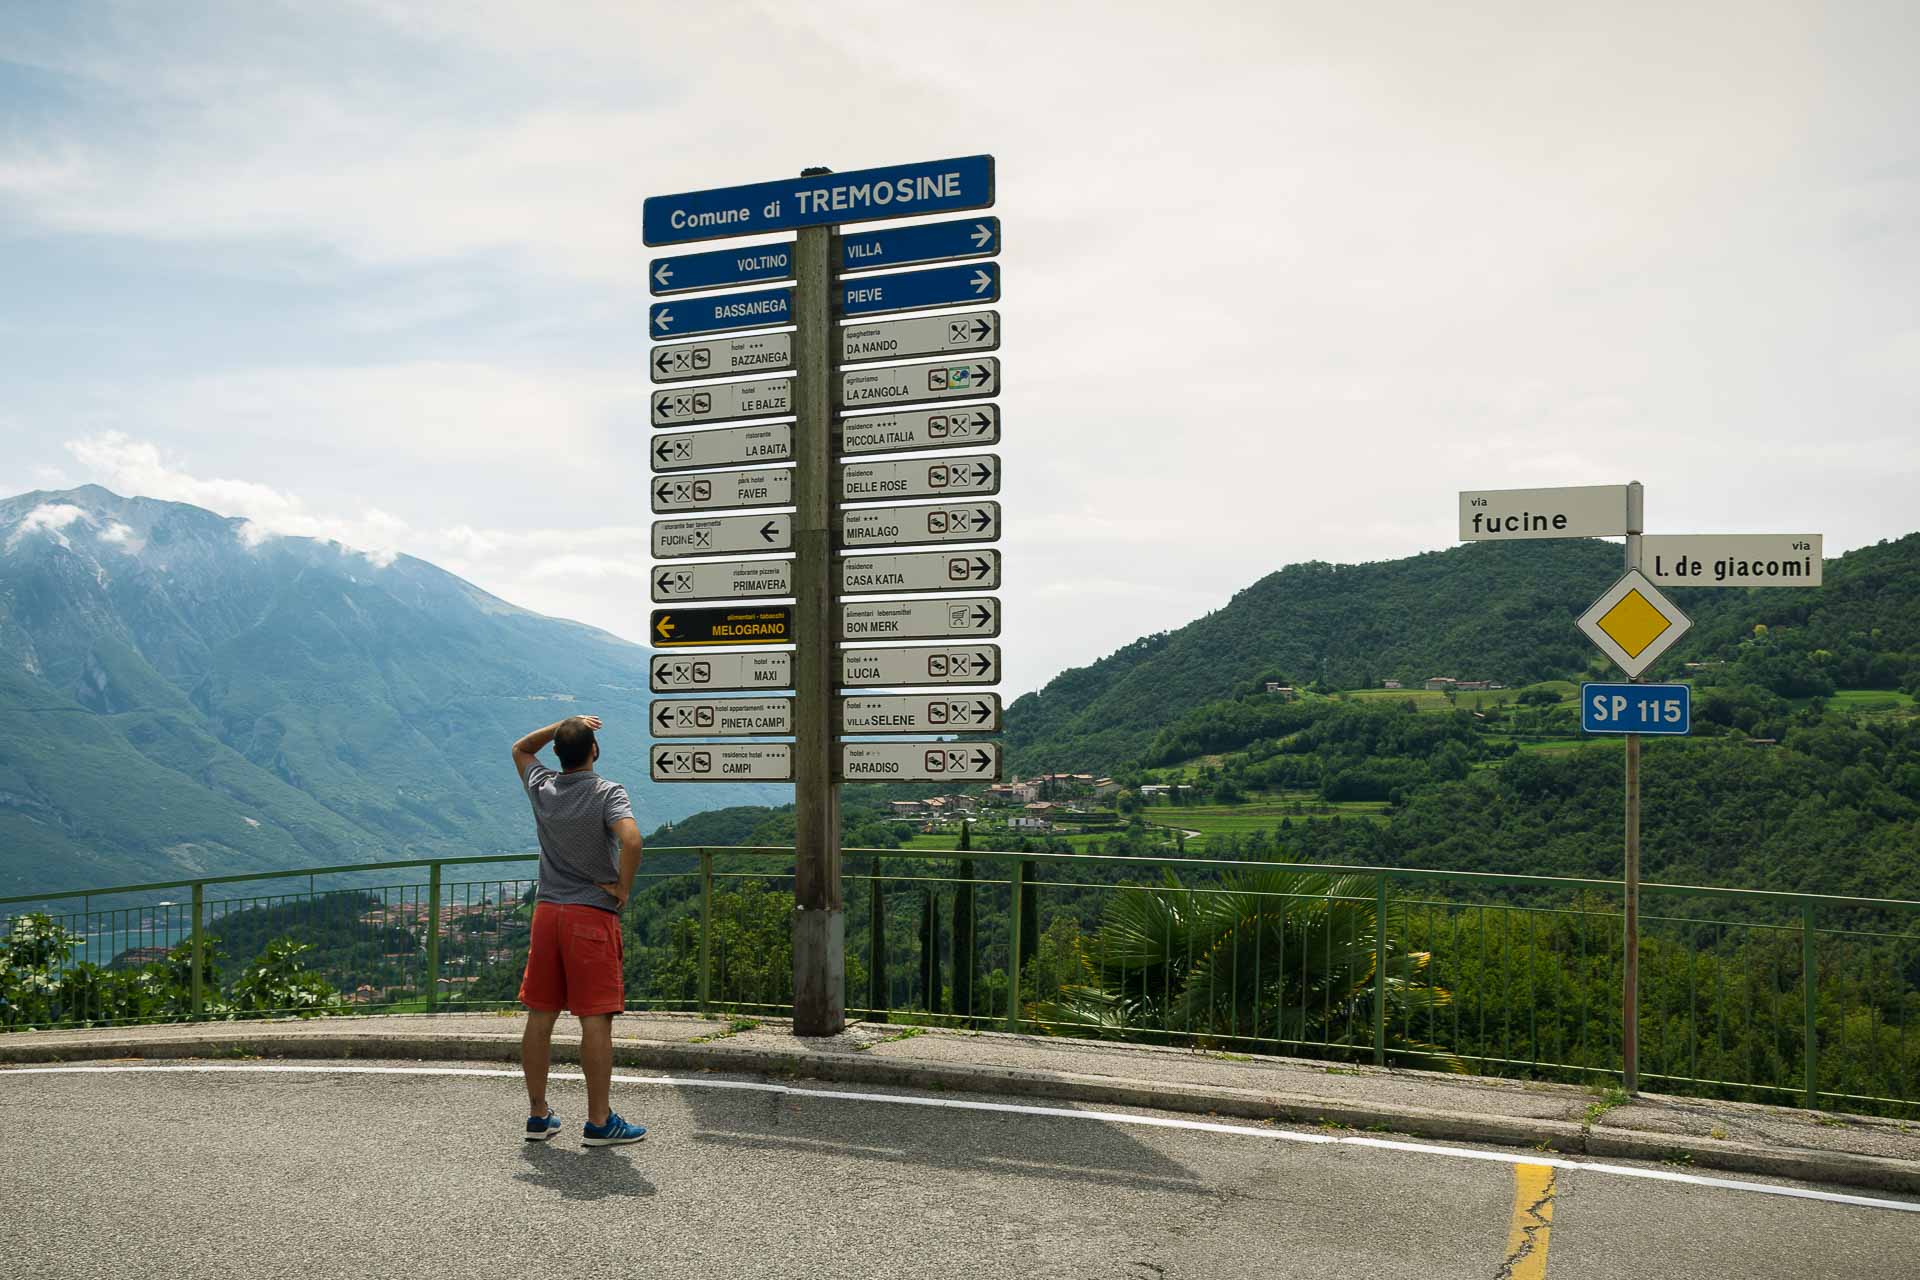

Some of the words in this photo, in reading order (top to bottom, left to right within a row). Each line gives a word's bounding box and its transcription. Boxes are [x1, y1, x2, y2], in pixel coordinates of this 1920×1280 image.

[670, 208, 750, 229] Comune
[763, 201, 781, 219] di
[794, 172, 961, 214] TREMOSINE
[848, 242, 883, 258] VILLA
[737, 254, 787, 272] VOLTINO
[848, 288, 882, 303] PIEVE
[715, 300, 787, 319] BASSANEGA
[847, 344, 860, 354] DA
[863, 340, 897, 352] NANDO
[731, 352, 788, 366] BAZZANEGA
[847, 389, 859, 400] LA
[862, 385, 909, 399] ZANGOLA
[742, 401, 754, 411] LE
[756, 398, 786, 410] BALZE
[847, 434, 885, 446] PICCOLA
[886, 432, 914, 443] ITALIA
[746, 446, 758, 456] LA
[760, 444, 787, 455] BAITA
[847, 482, 878, 493] DELLE
[880, 480, 907, 491] ROSE
[738, 488, 767, 498] FAVER
[1471, 498, 1488, 507] via
[1473, 512, 1568, 532] fucine
[847, 526, 899, 538] MIRALAGO
[661, 535, 694, 545] FUCINE
[1792, 541, 1811, 551] via
[1714, 556, 1811, 581] giacomi
[733, 580, 786, 591] PRIMAVERA
[847, 575, 873, 586] CASA
[876, 574, 904, 584] KATIA
[712, 624, 784, 636] MELOGRANO
[847, 622, 868, 633] BON
[870, 621, 898, 632] MERK
[754, 671, 777, 680] MAXI
[847, 668, 880, 678] LUCIA
[1593, 696, 1627, 721] SP
[1637, 700, 1681, 722] 115
[722, 718, 753, 728] PINETA
[756, 717, 784, 727] CAMPI
[871, 715, 915, 725] SELENE
[722, 764, 751, 773] CAMPI
[850, 763, 899, 772] PARADISO
